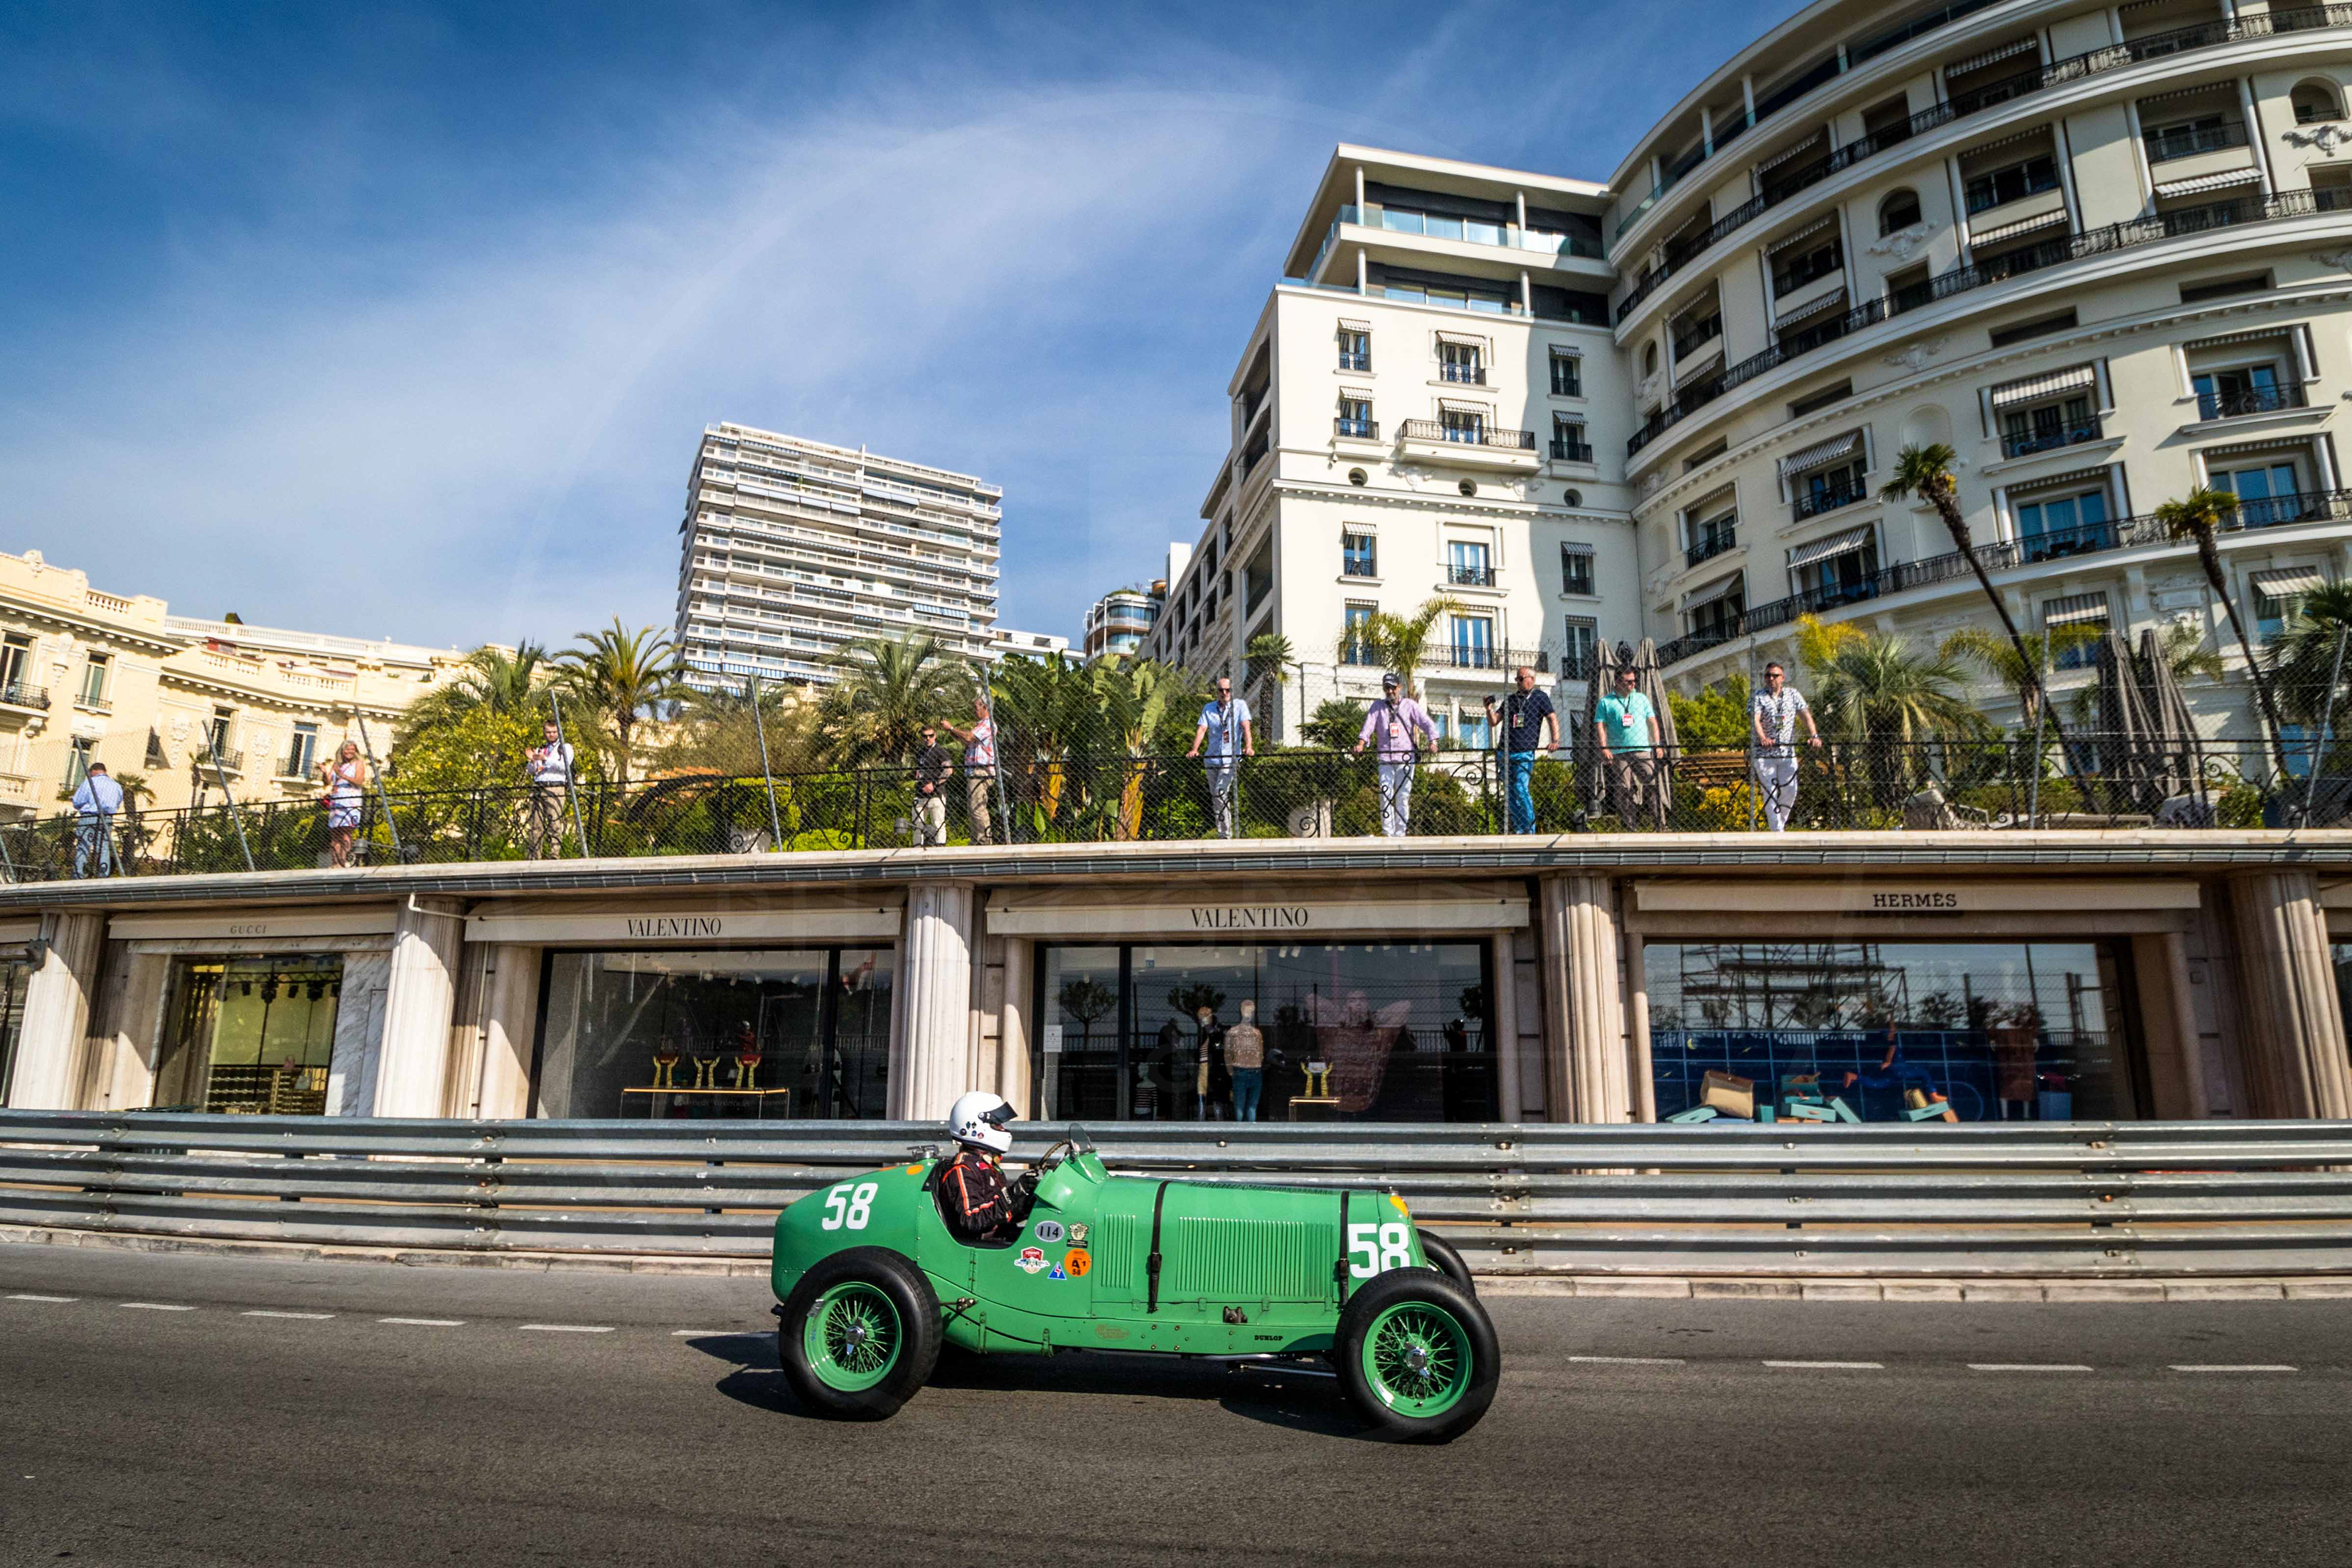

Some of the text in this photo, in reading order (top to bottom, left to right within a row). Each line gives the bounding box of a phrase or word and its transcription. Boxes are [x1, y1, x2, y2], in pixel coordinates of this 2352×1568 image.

[628, 918, 722, 937] VALENTINO
[1191, 907, 1308, 928] VALENTINO
[230, 925, 266, 935] GUCCI
[821, 1182, 878, 1230] 58
[1040, 1226, 1060, 1238] 114
[1348, 1223, 1410, 1278] 58
